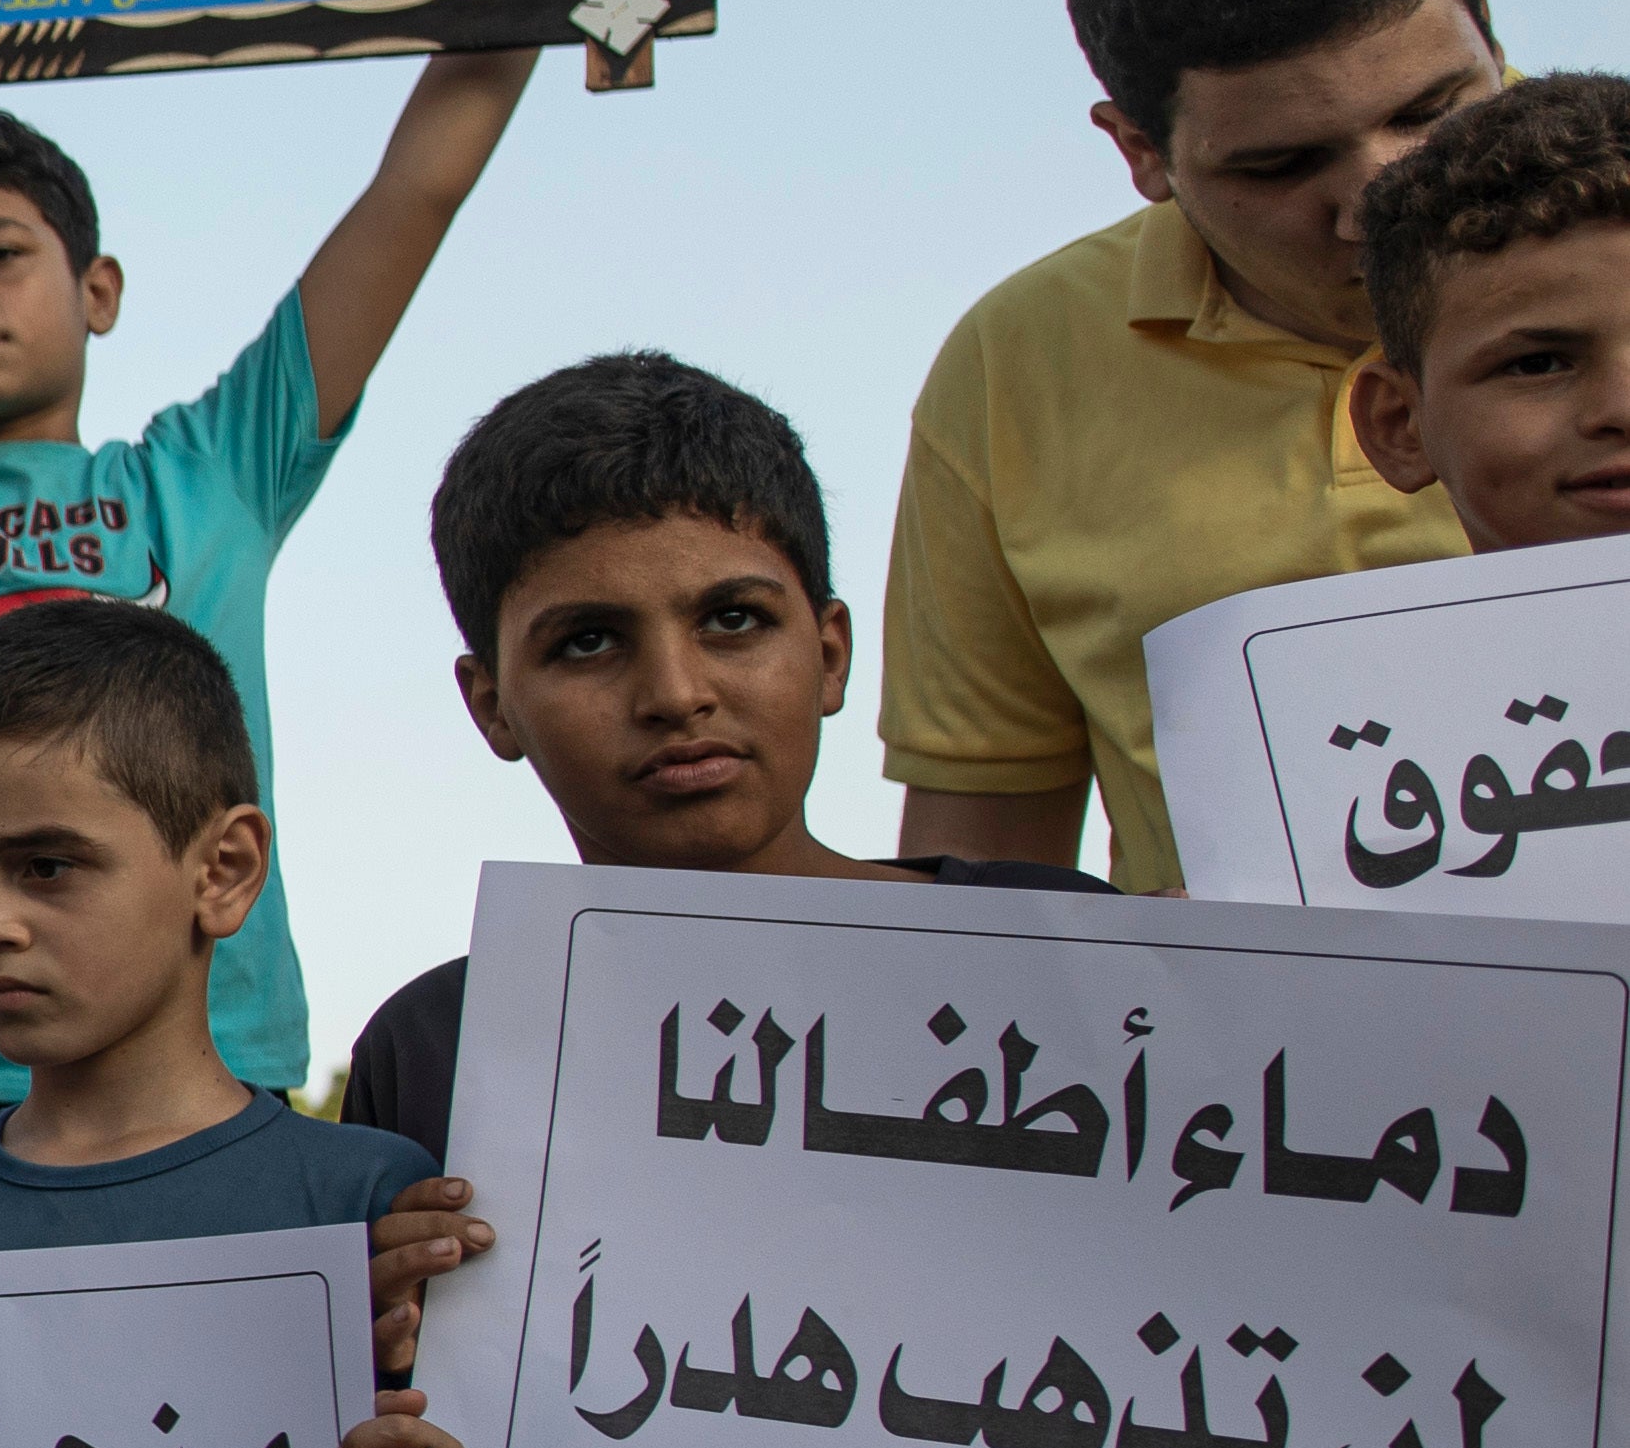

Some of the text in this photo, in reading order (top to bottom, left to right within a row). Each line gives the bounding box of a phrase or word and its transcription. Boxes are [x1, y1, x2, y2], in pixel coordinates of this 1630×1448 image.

[657, 998, 1528, 1219] دماء أطفالنا
[569, 1236, 859, 1441] هدراً
